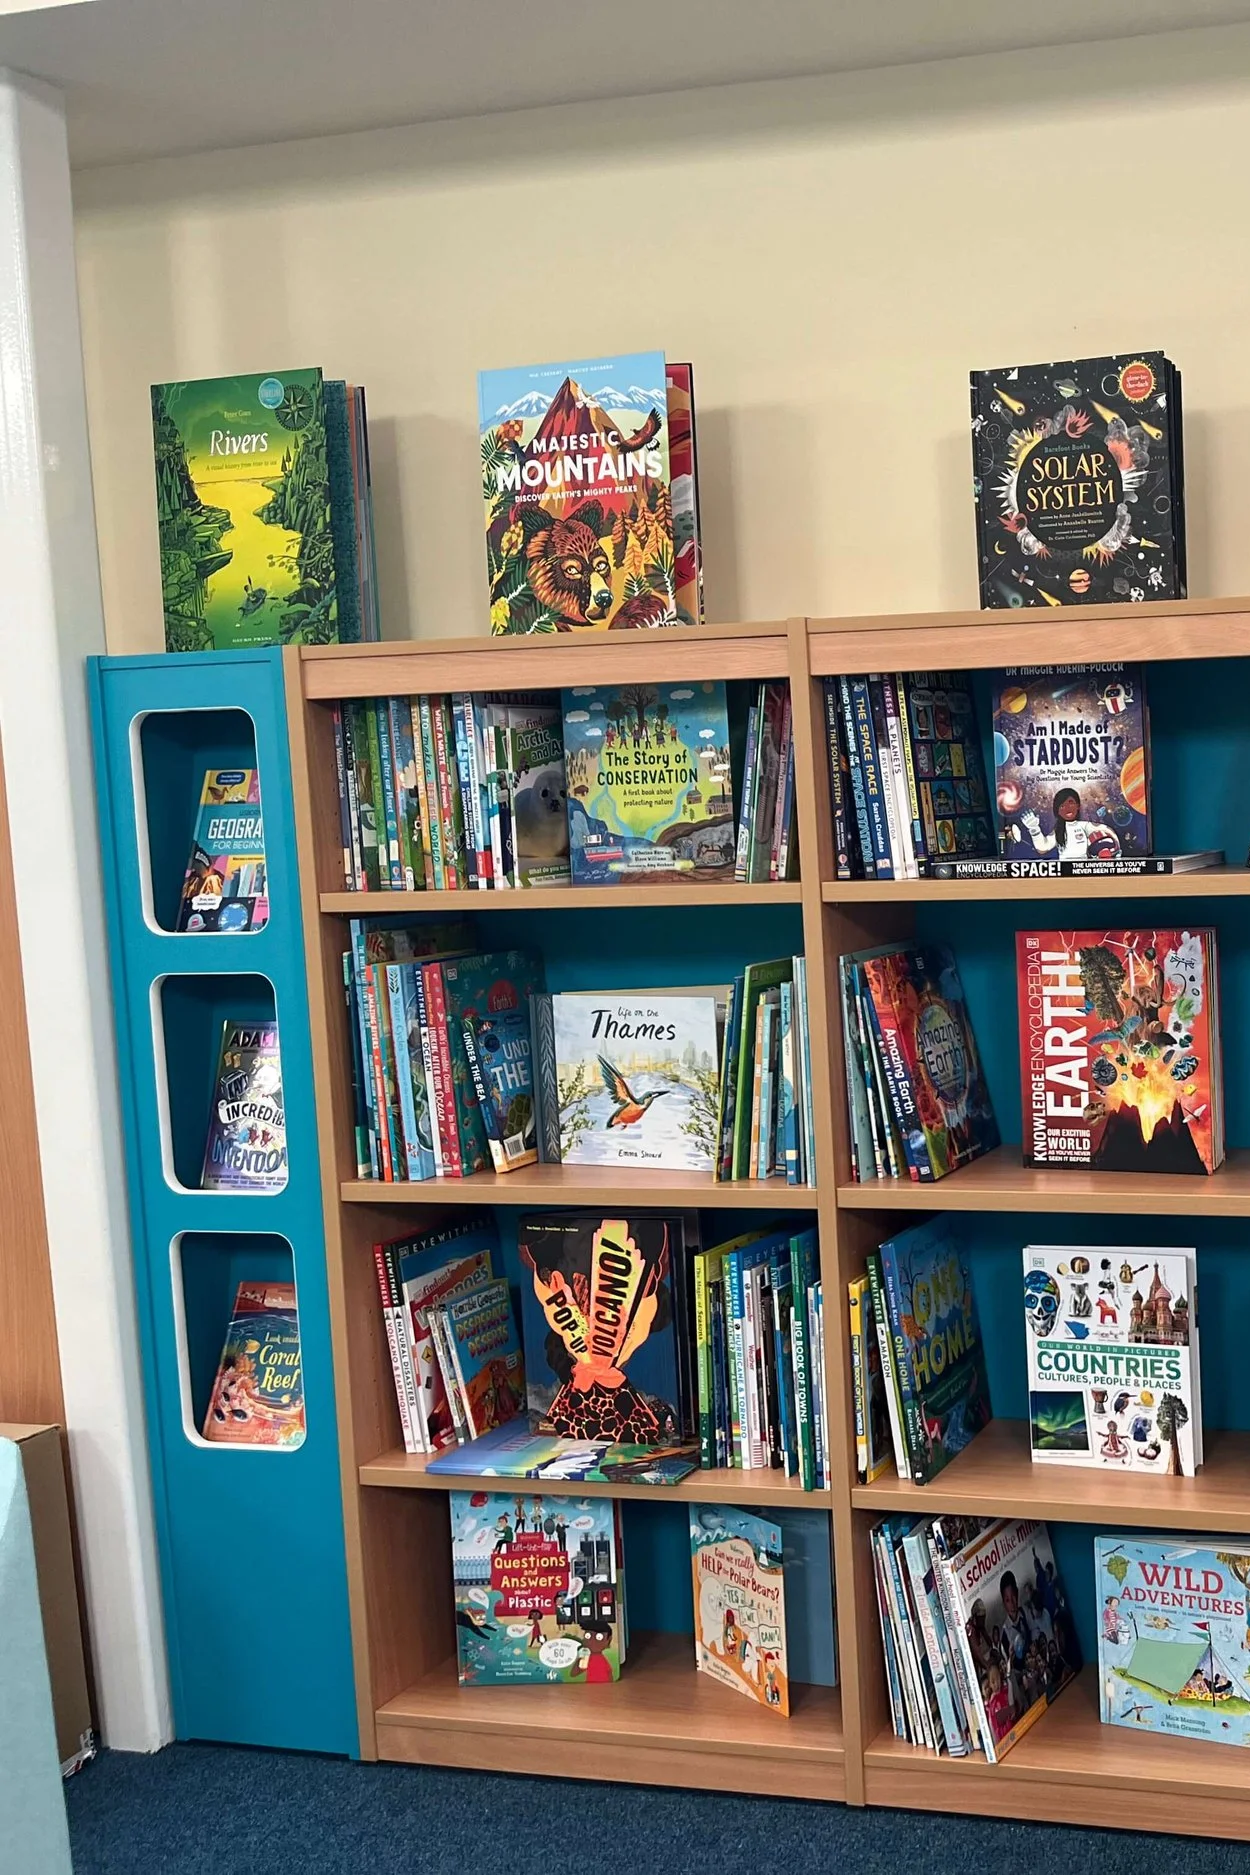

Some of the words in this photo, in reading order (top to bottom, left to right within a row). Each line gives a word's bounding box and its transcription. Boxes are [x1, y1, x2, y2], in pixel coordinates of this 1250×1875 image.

[208, 429, 269, 456] Rivers
[533, 431, 619, 454] MAJESTIC
[497, 450, 663, 493] MOUNTAINS
[1032, 453, 1107, 482] SOLAR
[515, 494, 551, 503] DISCOVER
[584, 487, 613, 496] MIGHTY
[615, 485, 637, 493] PEAKS
[1026, 480, 1115, 512] SYSTEM
[856, 697, 867, 720] THE
[517, 729, 550, 751] Arctic
[829, 729, 837, 744] THE
[860, 724, 872, 761] SPACE
[1028, 722, 1047, 737] Am
[1059, 720, 1091, 735] Made
[1095, 720, 1109, 734] of
[532, 746, 549, 760] and
[606, 752, 629, 766] The
[634, 751, 669, 768] Story
[674, 749, 687, 764] of
[831, 744, 839, 774] SOLAR
[890, 733, 902, 774] PLANETS
[1013, 736, 1124, 766] STARDUST?
[597, 768, 698, 786] CONSERVATION
[627, 788, 640, 796] first
[833, 774, 841, 804] SYSTEM
[865, 765, 878, 795] RACE
[212, 841, 231, 850] FOR
[956, 863, 1008, 873] KNOWLEDGE
[1011, 862, 1061, 877] SPACE!
[415, 970, 427, 1028] EYEWITNESS
[423, 1042, 432, 1072] OCEAN
[590, 1009, 676, 1041] Thames
[1026, 951, 1045, 1071] ENCYCLOPEDIA
[916, 1019, 962, 1049] Amazing
[463, 1032, 474, 1063] UNDER
[473, 1064, 481, 1083] THE
[477, 1083, 486, 1101] SEA
[491, 1061, 530, 1091] THE
[884, 1028, 905, 1079] Amazing
[898, 1079, 914, 1116] Earth
[924, 1046, 966, 1079] Earth
[1032, 1073, 1048, 1162] KNOWLEDGE
[1047, 1129, 1060, 1137] OUR
[1062, 1128, 1091, 1138] EXCITING
[1047, 1137, 1091, 1150] WORLD
[591, 1238, 633, 1358] VOLCANO!
[545, 1289, 588, 1360] POP-UP
[794, 1320, 803, 1339] BIG
[260, 1345, 300, 1366] Coral
[795, 1340, 804, 1369] BOOK
[879, 1339, 892, 1379] AMAZON
[895, 1335, 905, 1360] ONE
[913, 1317, 976, 1391] HOME
[261, 1367, 301, 1391] Reef
[797, 1371, 805, 1386] OF
[898, 1361, 911, 1392] HOME
[1037, 1350, 1182, 1381] COUNTRIES
[1038, 1371, 1091, 1385] CULTURES,
[1094, 1376, 1131, 1387] PEOPLE
[1134, 1378, 1140, 1387] &
[1143, 1380, 1182, 1390] PLACES
[402, 1360, 416, 1407] DISASTERS
[799, 1387, 808, 1424] TOWNS
[494, 1555, 566, 1570] Questions
[523, 1568, 538, 1576] and
[966, 1543, 1001, 1587] school
[1000, 1533, 1017, 1559] like
[501, 1575, 563, 1588] Answers
[701, 1553, 722, 1576] HELP
[730, 1568, 750, 1588] Polar
[751, 1579, 780, 1602] Bears?
[1138, 1561, 1223, 1594] WILD
[508, 1594, 552, 1609] Plastic
[1121, 1586, 1245, 1616] ADVENTURES
